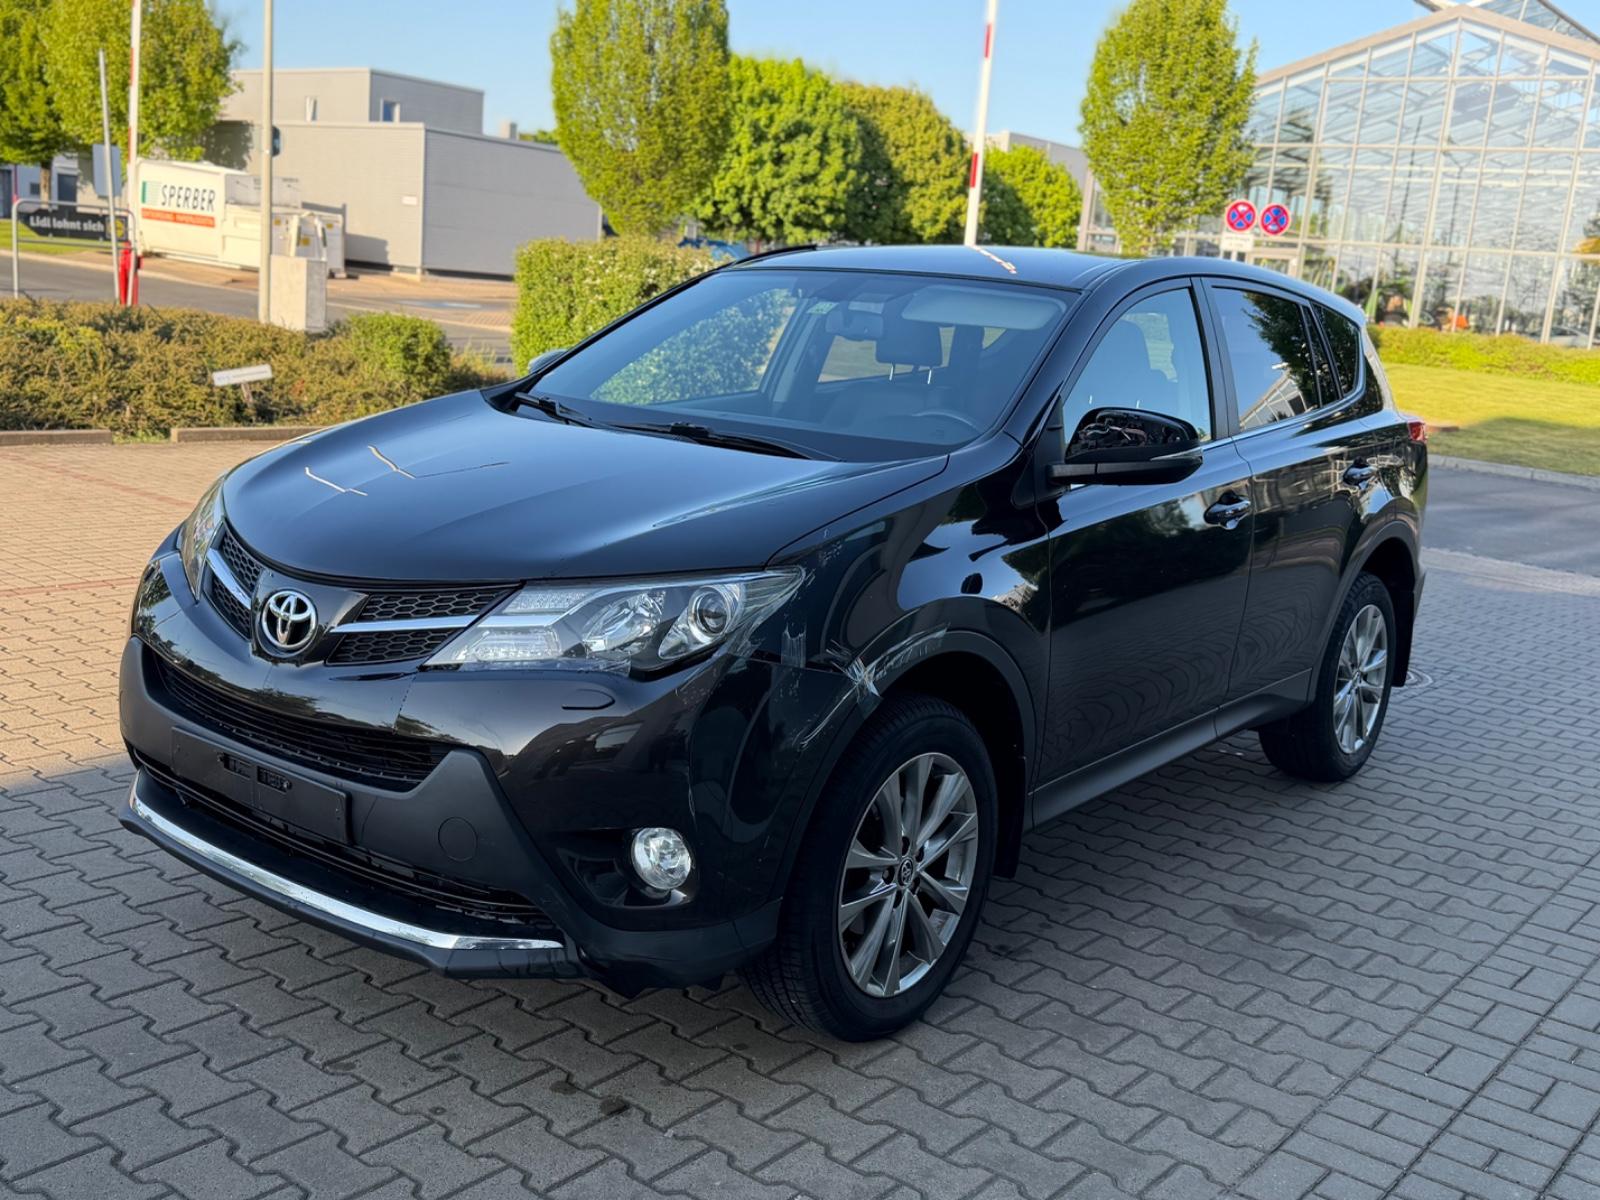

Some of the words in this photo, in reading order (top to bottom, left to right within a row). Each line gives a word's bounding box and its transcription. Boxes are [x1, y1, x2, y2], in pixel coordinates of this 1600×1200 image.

[161, 184, 216, 212] SPERBER
[29, 216, 51, 228] Lidl
[52, 217, 81, 230] lohnt
[83, 219, 104, 232] sich
